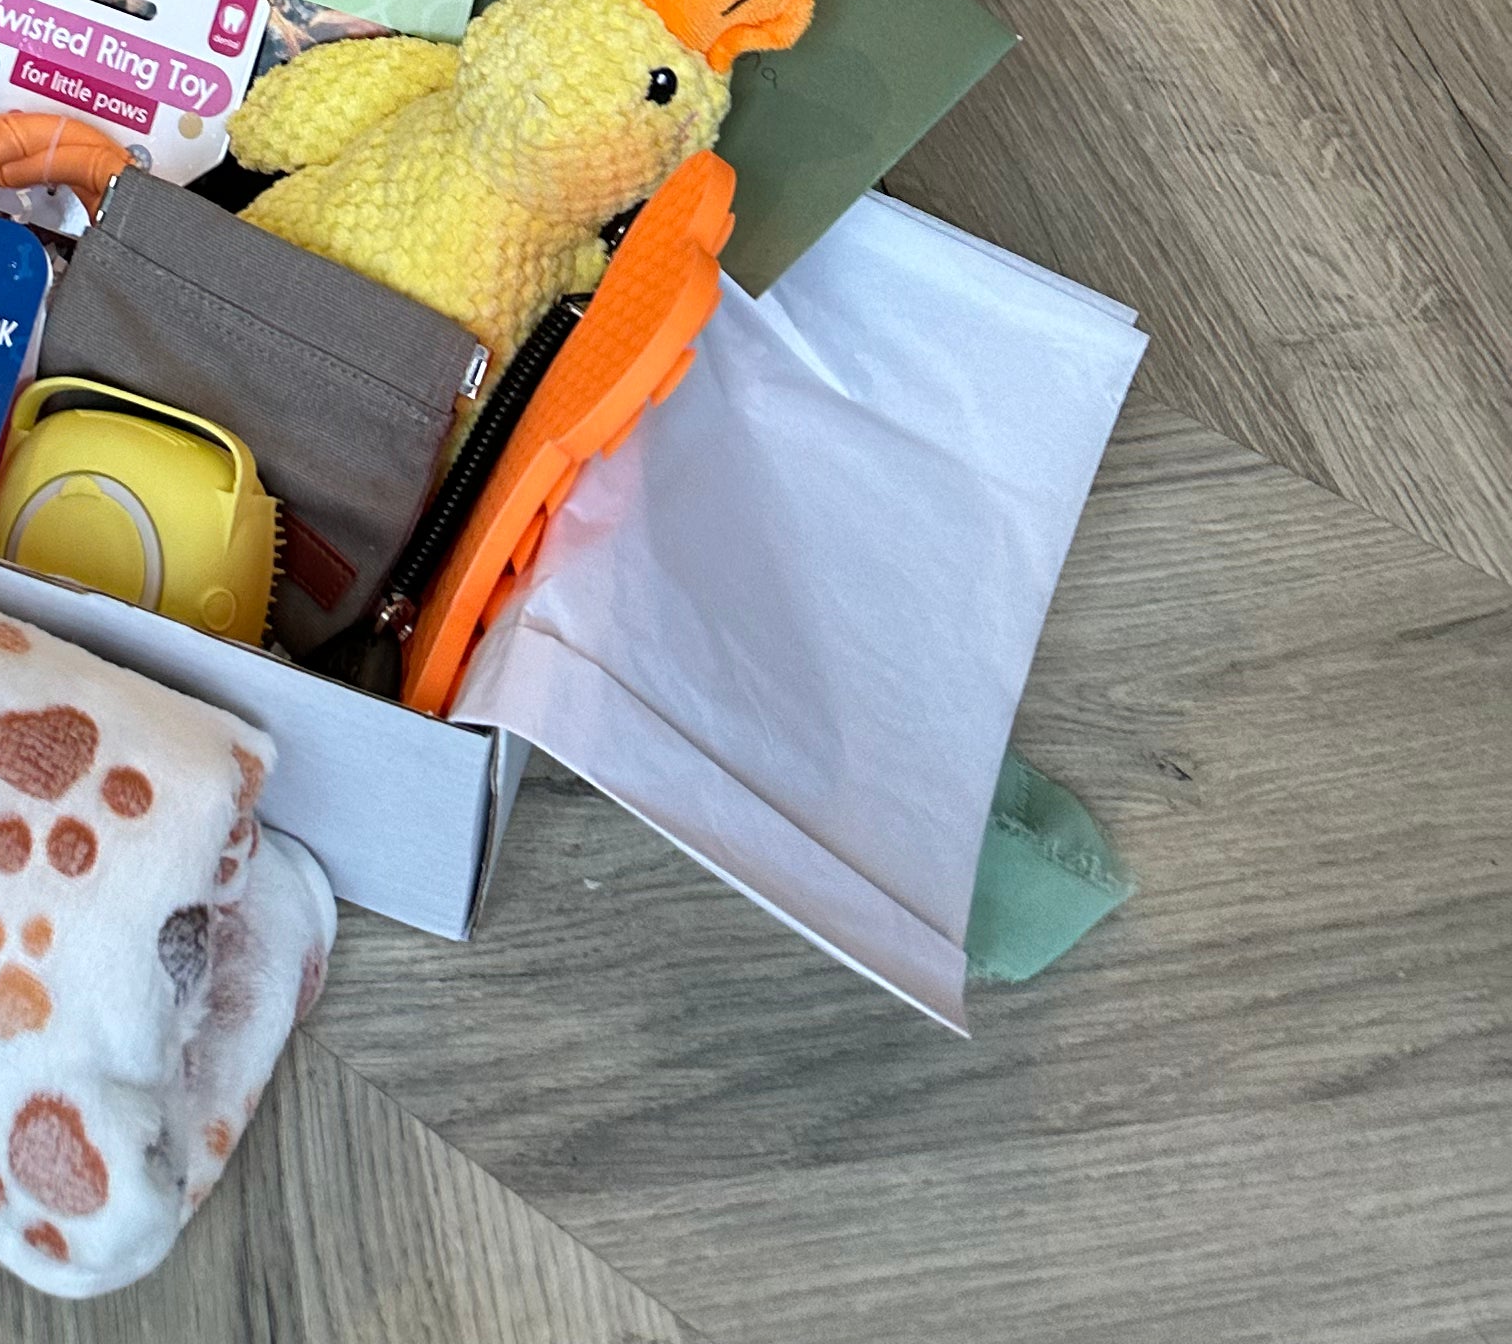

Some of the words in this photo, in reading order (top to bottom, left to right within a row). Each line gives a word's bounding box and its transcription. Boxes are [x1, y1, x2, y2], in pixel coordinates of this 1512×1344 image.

[21, 61, 50, 87] for
[50, 70, 92, 103] little
[92, 90, 149, 124] paws
[96, 34, 160, 90] Ring
[166, 58, 219, 111] Toy
